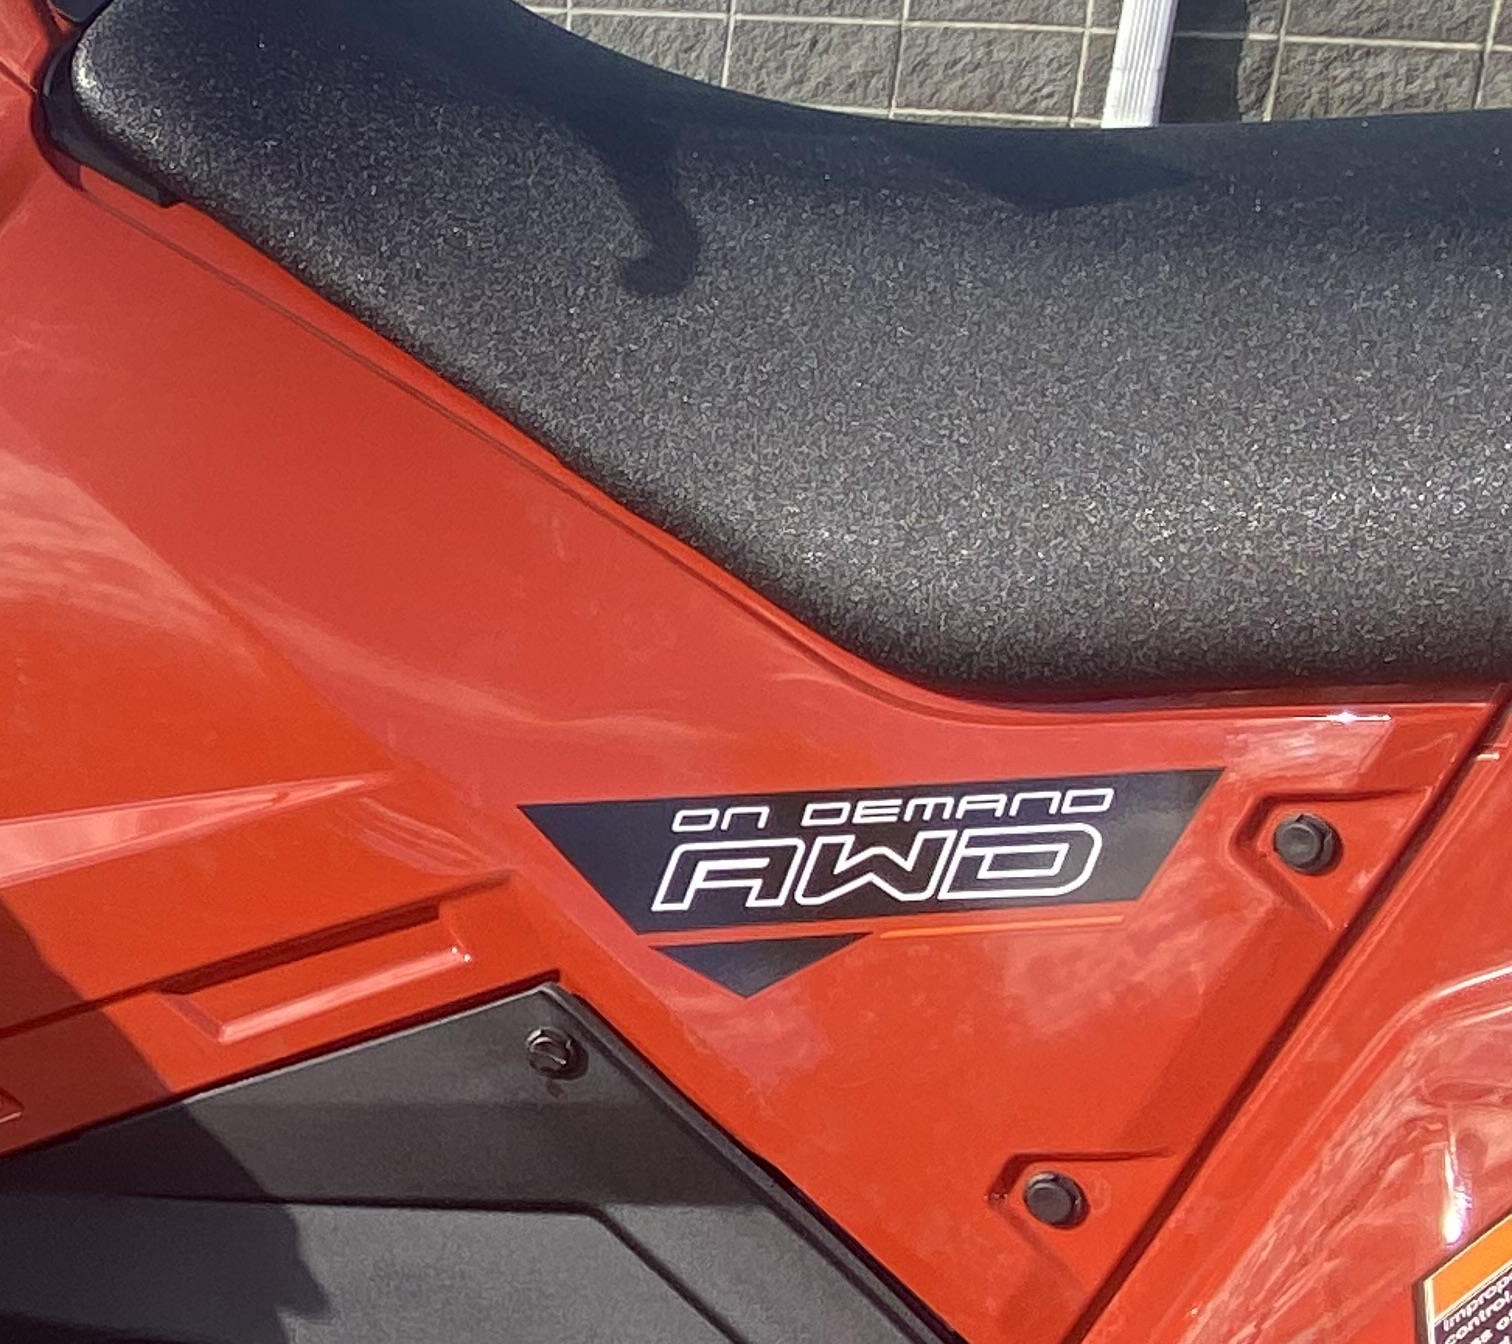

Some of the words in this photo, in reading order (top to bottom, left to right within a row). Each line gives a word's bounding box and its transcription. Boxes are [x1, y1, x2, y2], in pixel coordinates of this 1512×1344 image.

[671, 806, 770, 833] ON
[801, 788, 1114, 828] DEMAND
[651, 822, 1104, 913] AWD
